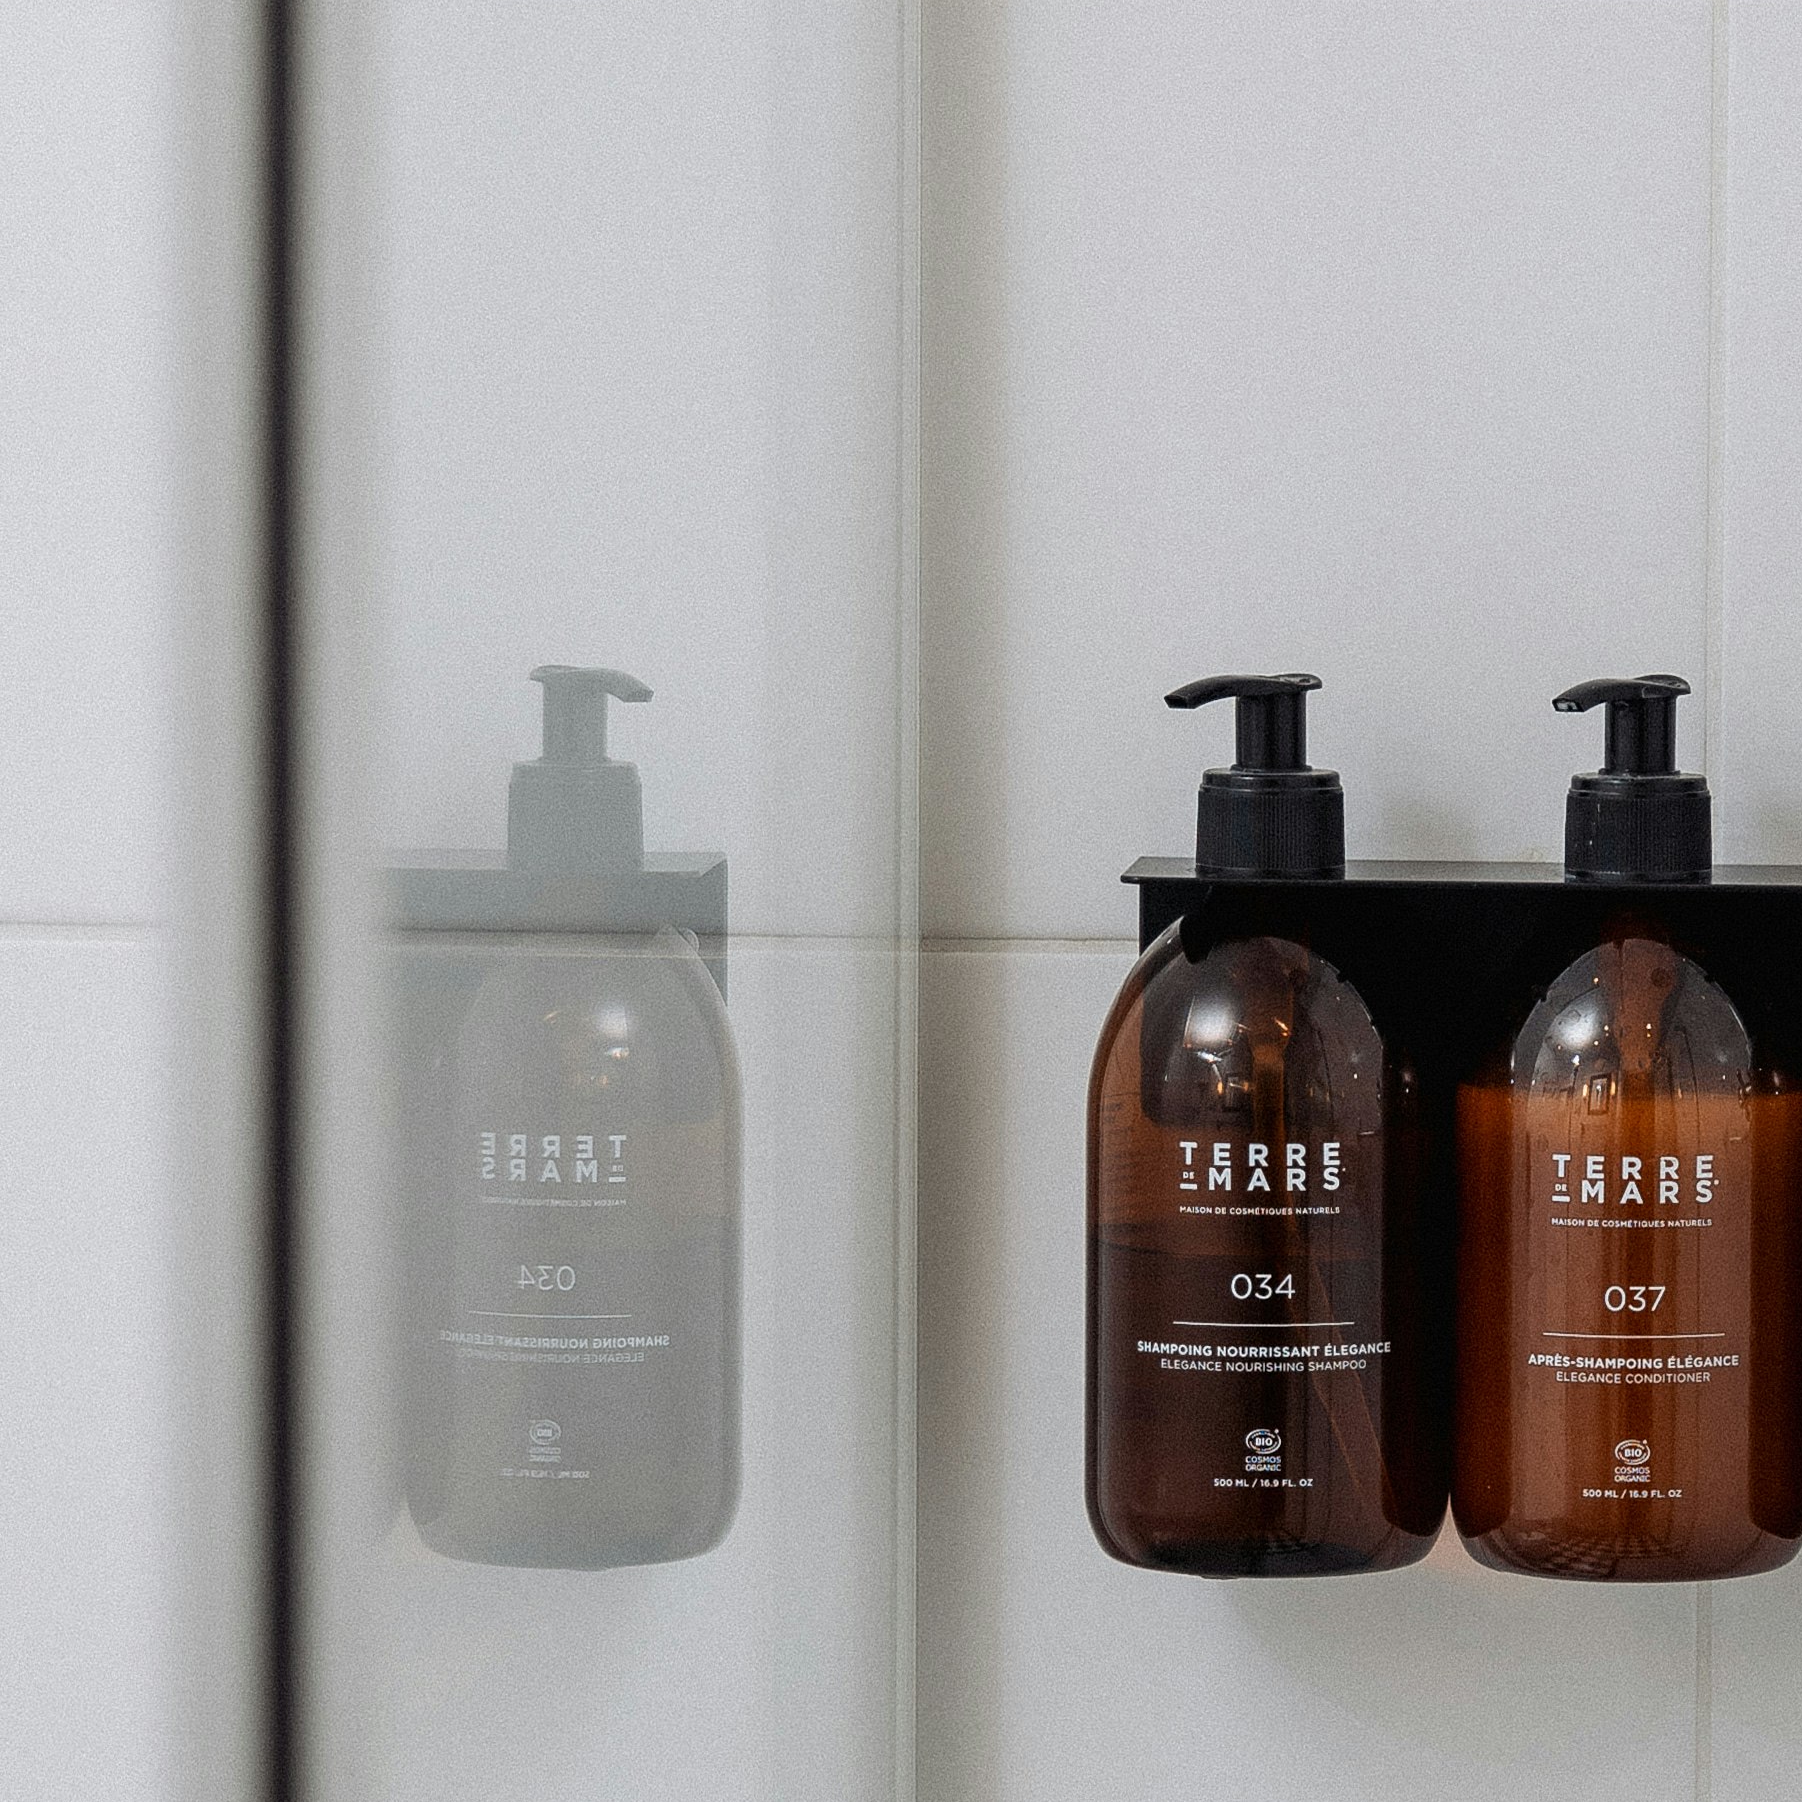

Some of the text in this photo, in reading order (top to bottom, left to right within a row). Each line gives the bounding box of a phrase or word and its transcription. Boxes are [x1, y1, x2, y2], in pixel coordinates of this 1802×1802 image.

[1179, 1141, 1341, 1167] TERRE
[1552, 1153, 1714, 1180] TERRE
[1182, 1167, 1340, 1192] DE MARS
[1555, 1179, 1714, 1205] DE MARS
[1180, 1206, 1340, 1216] MAISON DE COSMÉTIQUES NATURELS
[1551, 1217, 1713, 1228] MAISON DE COSMÉTIQUES NATURELS
[1231, 1273, 1296, 1300] 034
[1604, 1285, 1667, 1312] 037
[1137, 1340, 1213, 1357] SHAMPOING
[1217, 1345, 1319, 1358] NOURRISSANT
[1160, 1358, 1367, 1372] ELEGANCE NOURISHING SHAMPOO
[1528, 1353, 1739, 1369] APRÈS-SHAMPOING ÉLÉGANCE
[1556, 1371, 1711, 1384] ELEGANCE CONDITIONER
[1255, 1437, 1273, 1447] BIO
[1624, 1448, 1643, 1458] BIO
[1245, 1455, 1282, 1464] COSMOS
[1245, 1464, 1282, 1472] ORGANIC
[1614, 1466, 1651, 1475] COSMOS
[1213, 1478, 1233, 1487] 500
[1235, 1479, 1250, 1487] ML
[1260, 1479, 1279, 1488] 16.9
[1281, 1479, 1296, 1488] FL.
[1299, 1478, 1313, 1487] OZ
[1614, 1474, 1651, 1483] ORGANIC
[1582, 1489, 1602, 1498] 500
[1604, 1489, 1619, 1498] ML
[1629, 1490, 1648, 1498] 16.9
[1650, 1489, 1666, 1498] FL.
[1668, 1489, 1682, 1498] OZ
